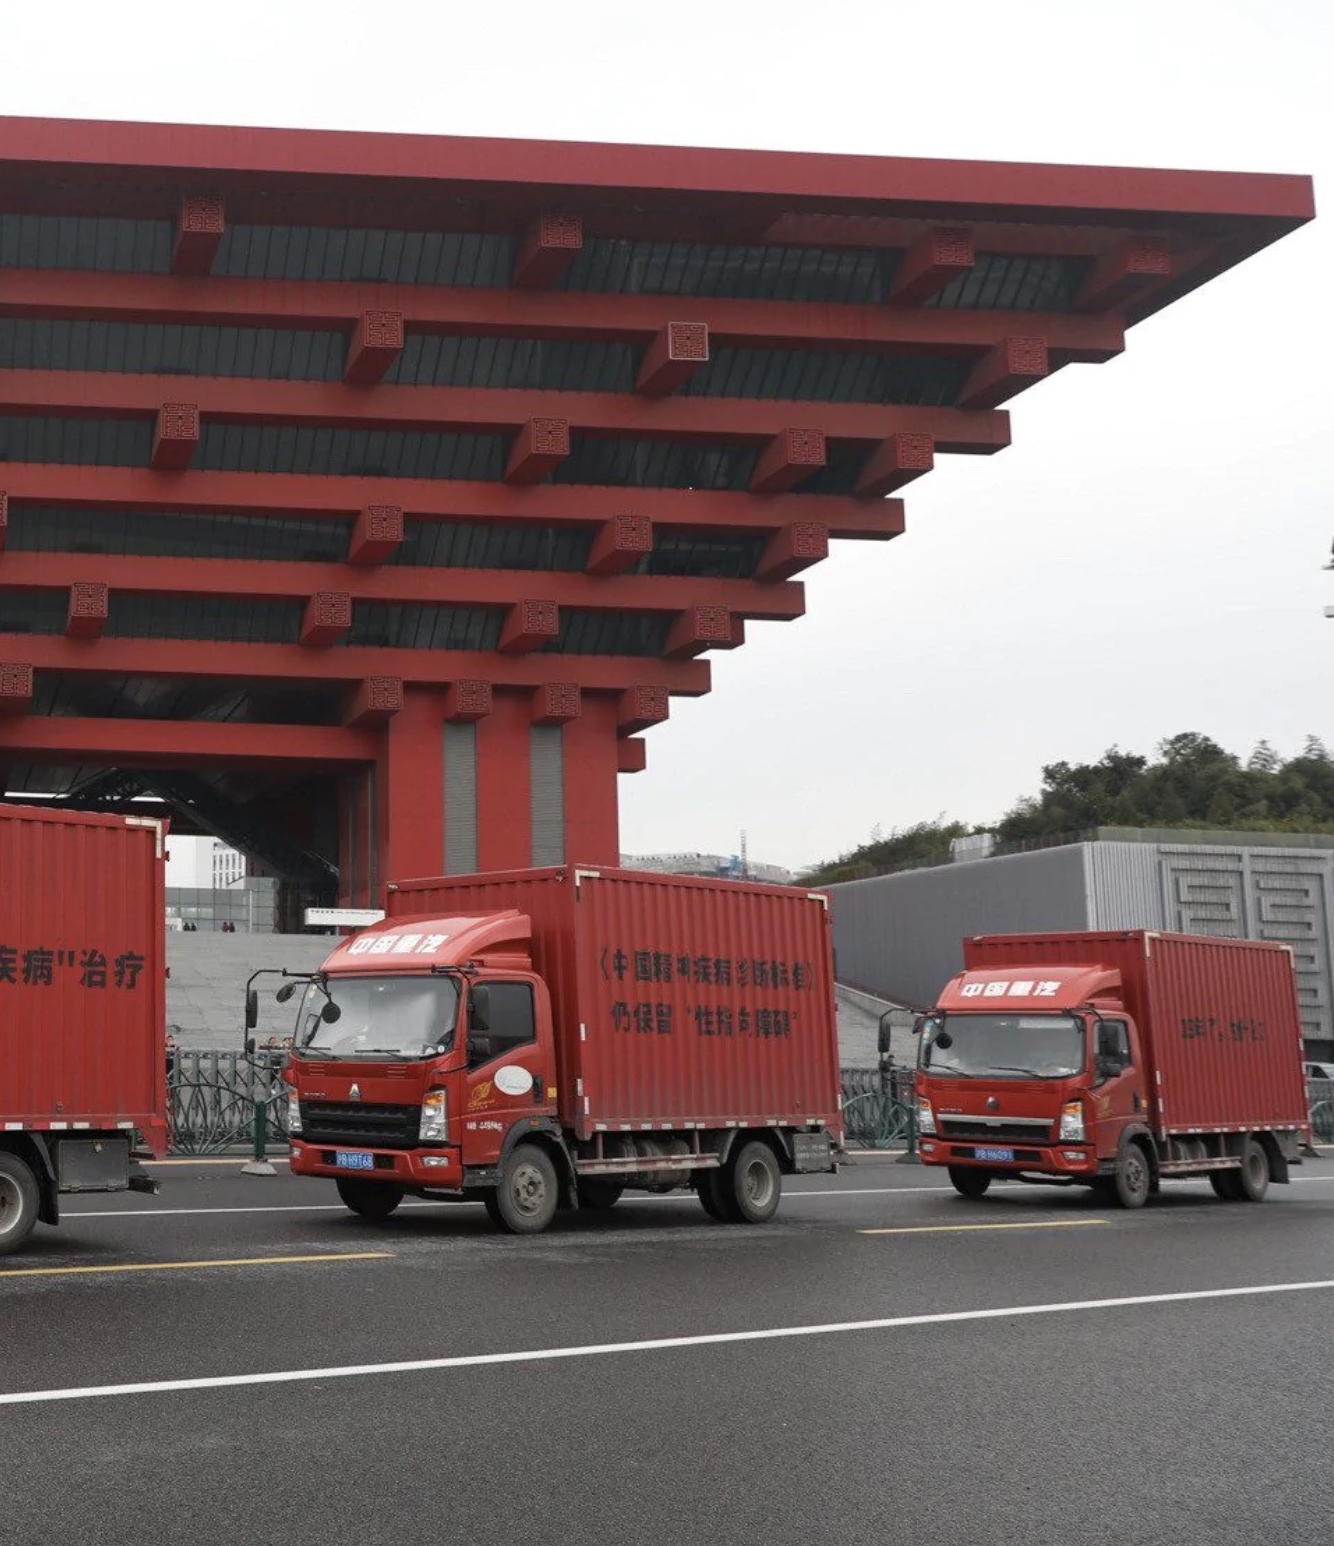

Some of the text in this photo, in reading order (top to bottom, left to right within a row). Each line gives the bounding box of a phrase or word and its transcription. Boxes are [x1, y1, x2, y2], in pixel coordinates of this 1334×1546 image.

[348, 933, 450, 955] 中国重汽
[960, 980, 1062, 997] 中国重汽
